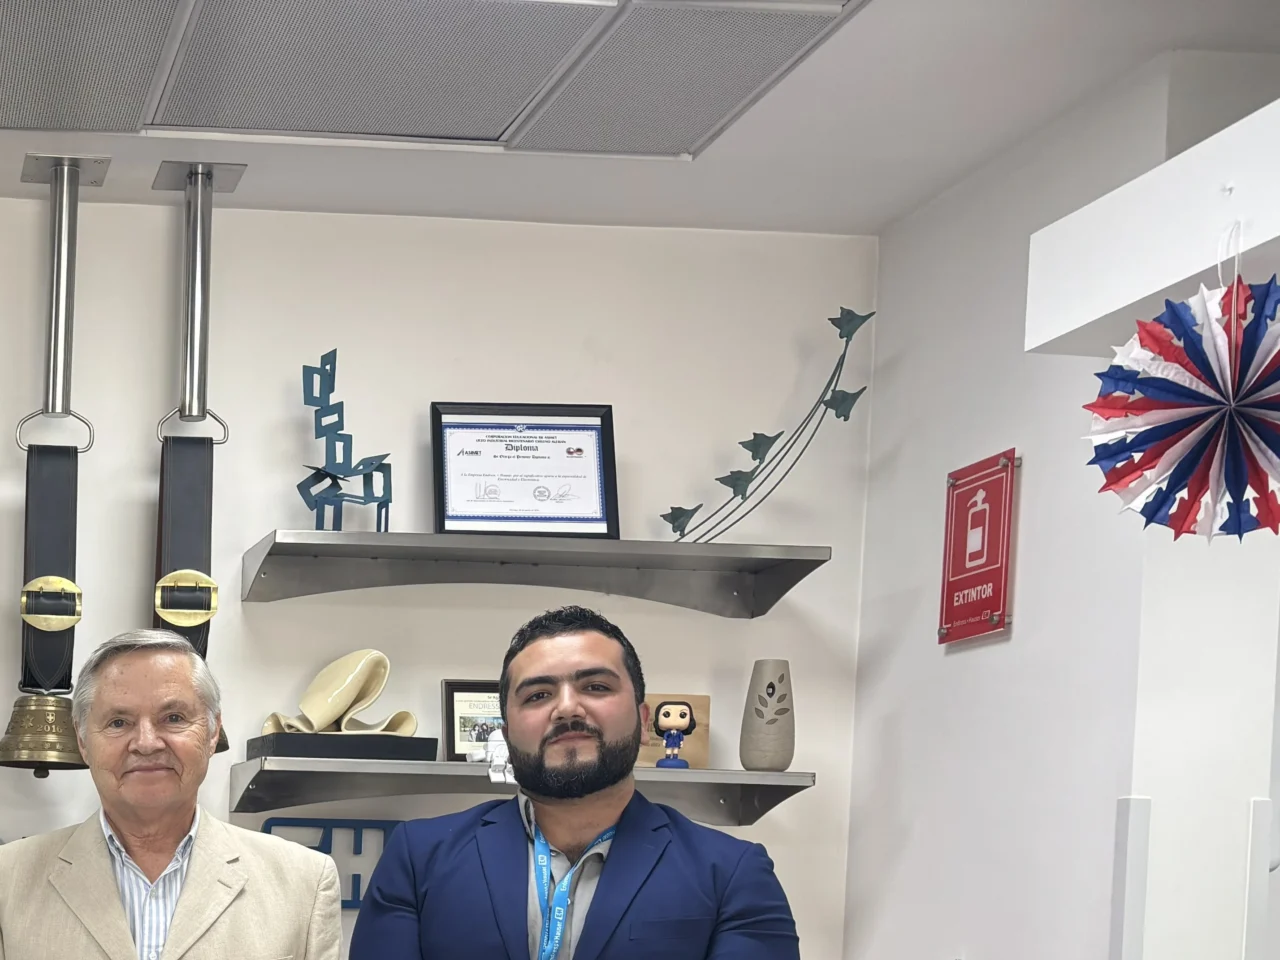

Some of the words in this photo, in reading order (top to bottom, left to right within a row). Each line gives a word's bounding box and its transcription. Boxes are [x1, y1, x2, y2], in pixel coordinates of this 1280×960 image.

[504, 443, 539, 452] Diploma
[953, 583, 993, 607] EXTINTOR
[36, 725, 63, 733] 2016
